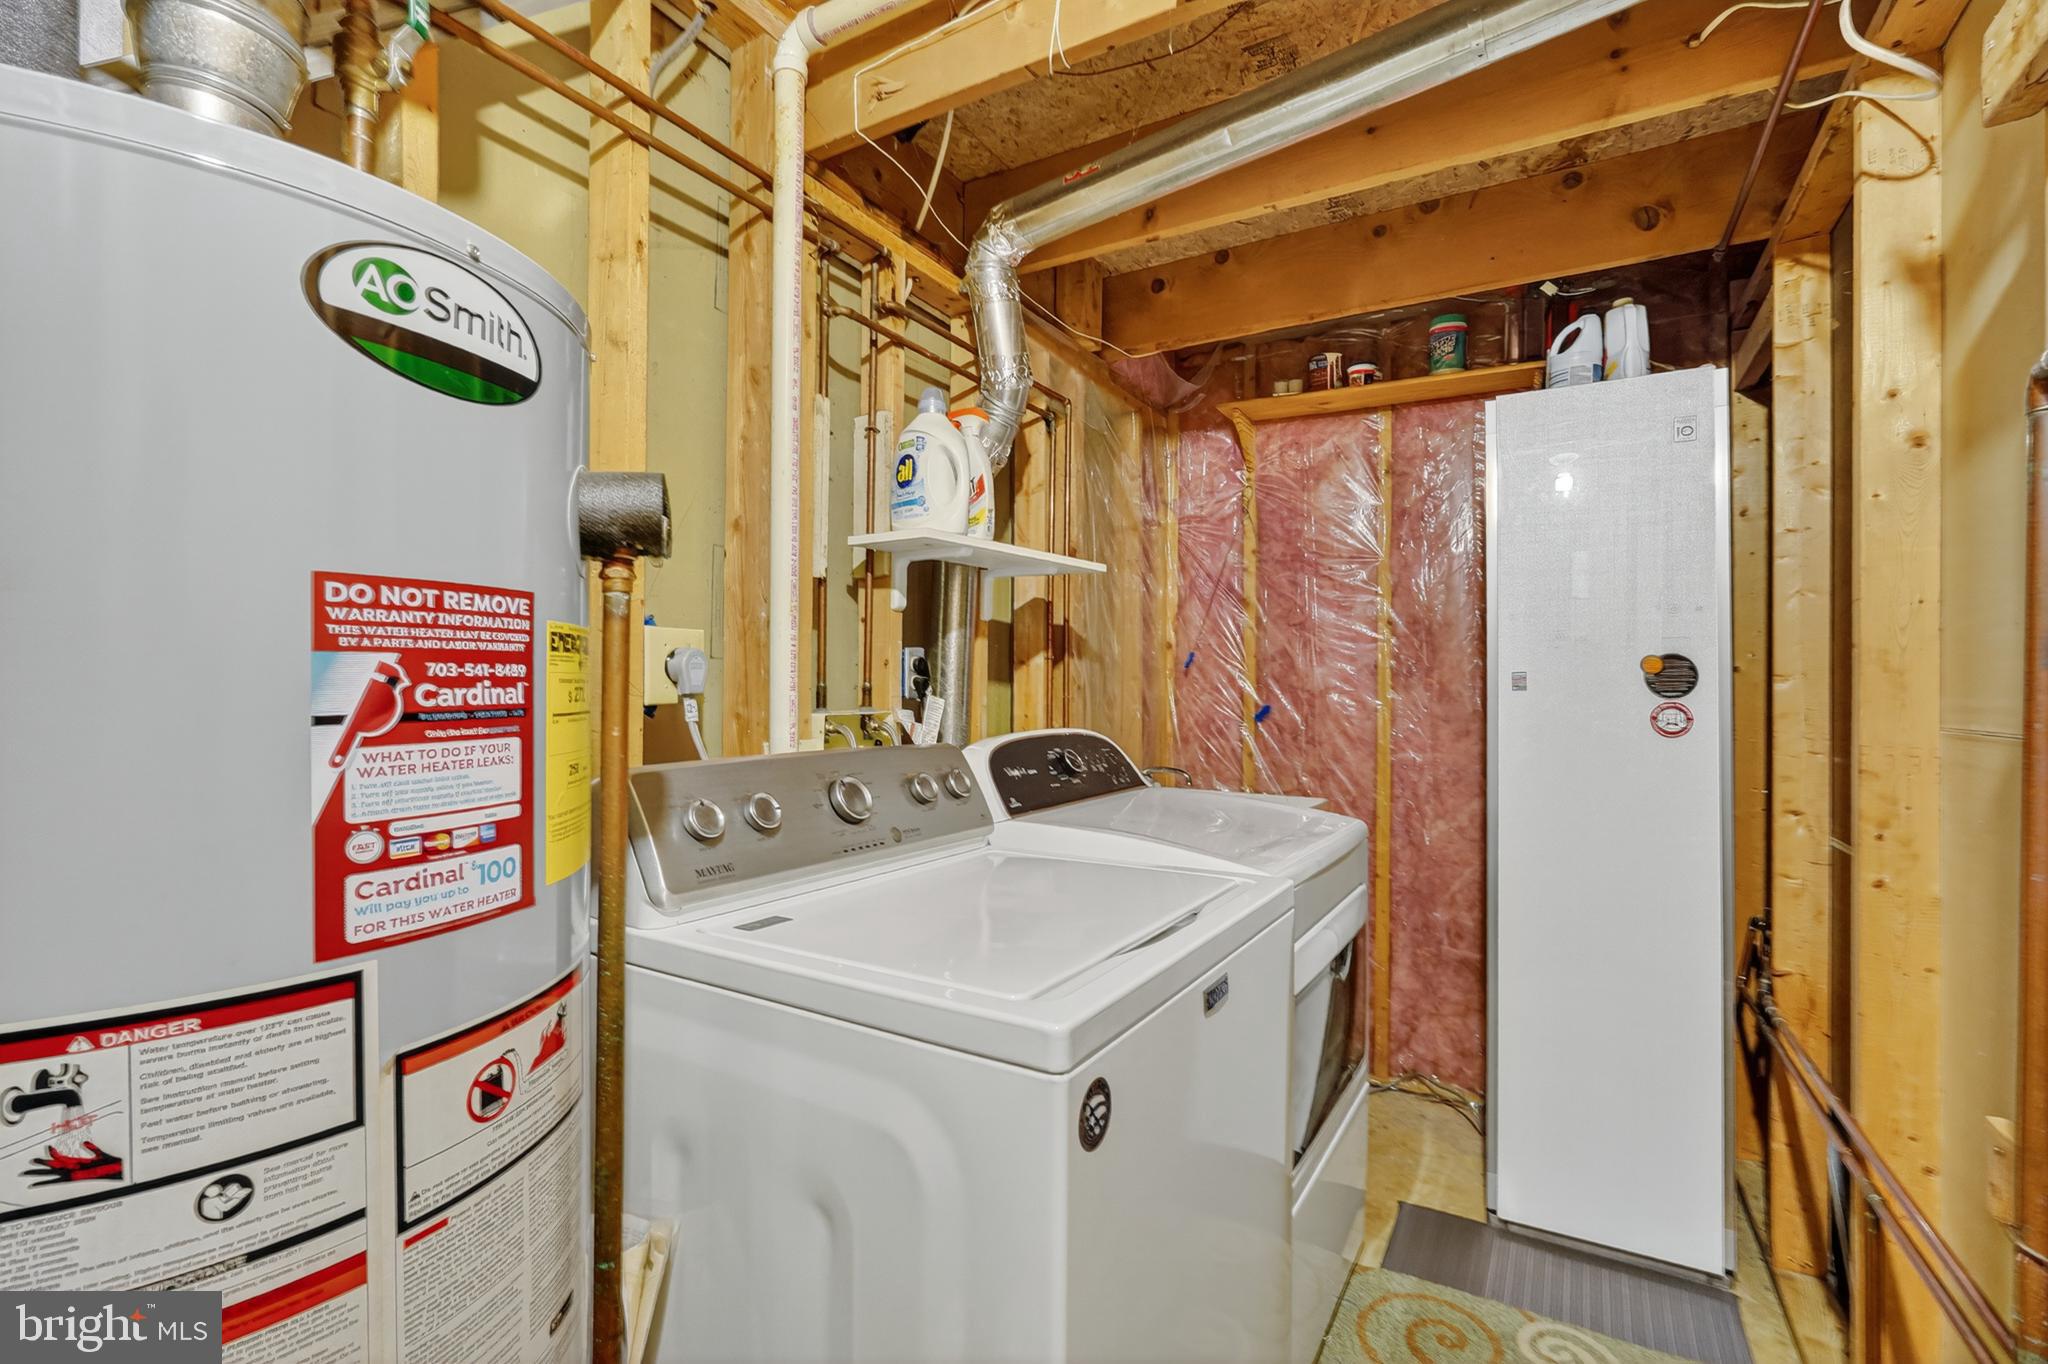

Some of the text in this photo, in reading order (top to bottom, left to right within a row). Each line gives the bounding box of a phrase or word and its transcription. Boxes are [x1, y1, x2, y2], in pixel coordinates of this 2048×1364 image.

[897, 458, 913, 483] all
[324, 581, 530, 615] DO NOT REMOVE
[325, 606, 530, 631] WARRANTY INFORMATION
[326, 624, 362, 635] THIS
[364, 625, 409, 636] WATER
[338, 636, 360, 647] BY
[373, 638, 413, 649] PARTS
[416, 640, 443, 649] AND
[414, 680, 526, 707] Cardinal
[362, 743, 511, 764] WHAT TO DO IF YOUR
[356, 755, 514, 778] WATER HEATER LEAKS:
[352, 842, 377, 851] FAST
[354, 856, 516, 900] Cardinal $100
[354, 886, 470, 916] Will pay you up to
[354, 888, 517, 936] FOR THIS WATER HEATER
[100, 1018, 202, 1049] DANGER
